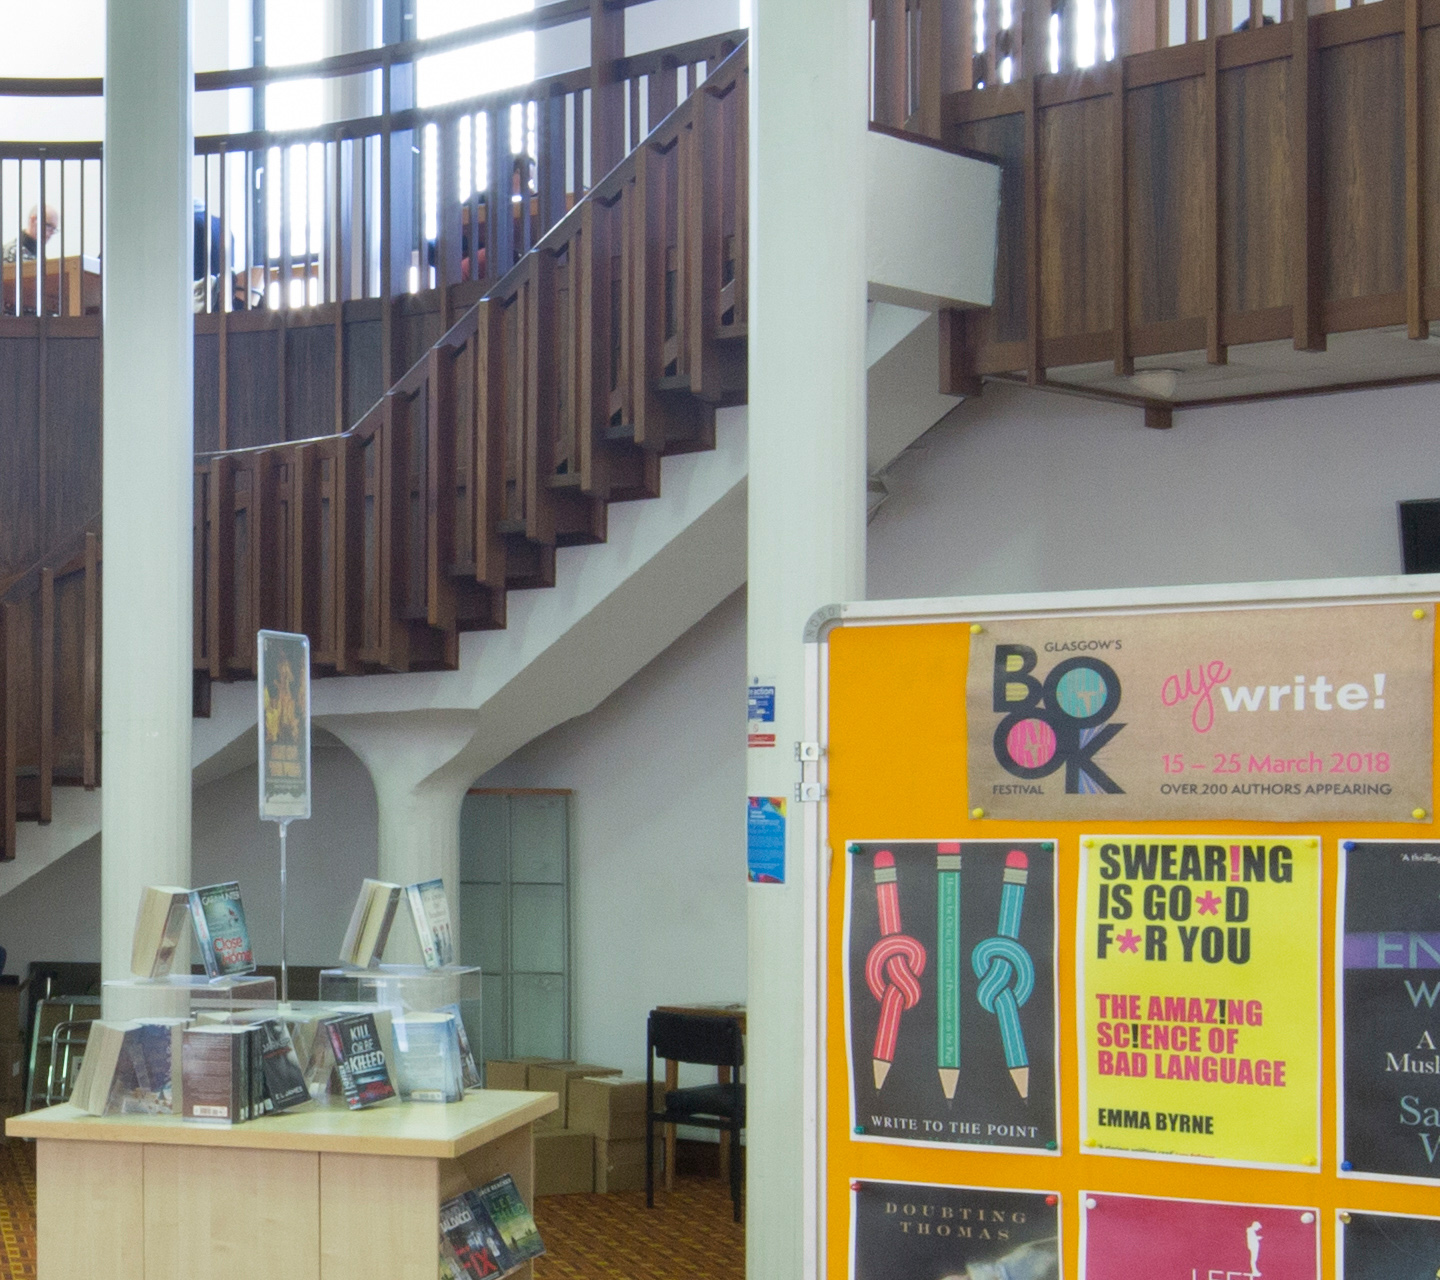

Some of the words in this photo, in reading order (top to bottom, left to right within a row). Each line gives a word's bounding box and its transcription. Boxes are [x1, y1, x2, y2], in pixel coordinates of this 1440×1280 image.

[1045, 639, 1122, 653] GLASGOW'S
[1161, 660, 1232, 733] aye
[1220, 673, 1386, 712] write!
[1162, 754, 1185, 774] 15
[1214, 754, 1241, 774] 25
[1248, 752, 1322, 774] March
[1330, 751, 1390, 773] 2018
[992, 784, 1044, 795] FESTIVAL
[1160, 783, 1199, 795] OVER
[1201, 783, 1228, 795] 200
[1231, 783, 1301, 795] AUTHORS
[1305, 782, 1392, 796] APPEARING
[1099, 844, 1293, 882] SWEAR!NG
[1098, 884, 1132, 920] IS
[214, 936, 243, 952] Close
[1178, 926, 1250, 964] YOU
[1096, 994, 1141, 1020] THE
[1147, 996, 1263, 1026] AMAZ!NG
[349, 1023, 370, 1041] KILL
[1097, 1022, 1201, 1052] SC!ENCE
[1208, 1027, 1239, 1054] OF
[1416, 1030, 1436, 1050] A
[348, 1051, 386, 1072] KILLED
[1098, 1051, 1148, 1078] BAD
[1154, 1054, 1286, 1087] LANGUAGE
[871, 1115, 918, 1131] WRITE
[923, 1120, 943, 1132] TO
[949, 1121, 981, 1135] THE
[987, 1125, 1038, 1138] POINT
[1098, 1108, 1151, 1130] EMMA
[1155, 1112, 1214, 1134] BYRNE
[885, 1201, 1027, 1225] DOUBTING
[900, 1220, 1012, 1241] THOMAS
